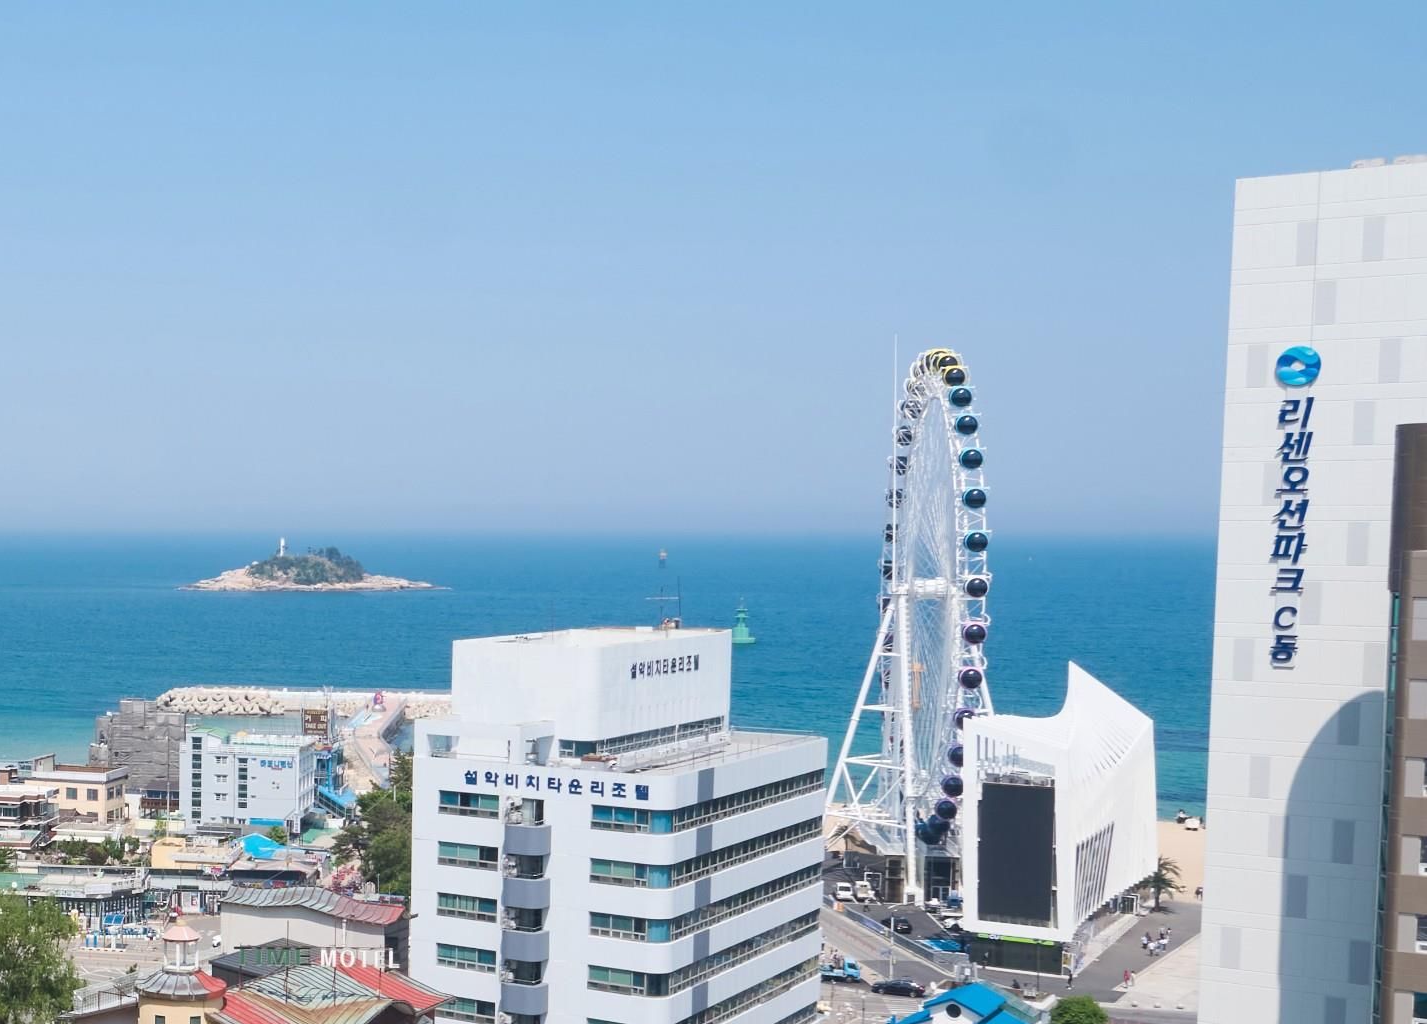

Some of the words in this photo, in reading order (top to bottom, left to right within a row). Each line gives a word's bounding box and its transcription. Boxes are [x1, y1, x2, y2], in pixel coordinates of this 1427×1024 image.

[1270, 396, 1315, 593] 리센오션파크
[1270, 605, 1299, 666] C동
[629, 653, 701, 680] 설악비치타운리조텔
[463, 769, 650, 801] 설악비치타운리조텔
[235, 948, 310, 966] TIME
[319, 948, 401, 969] MOTEL
